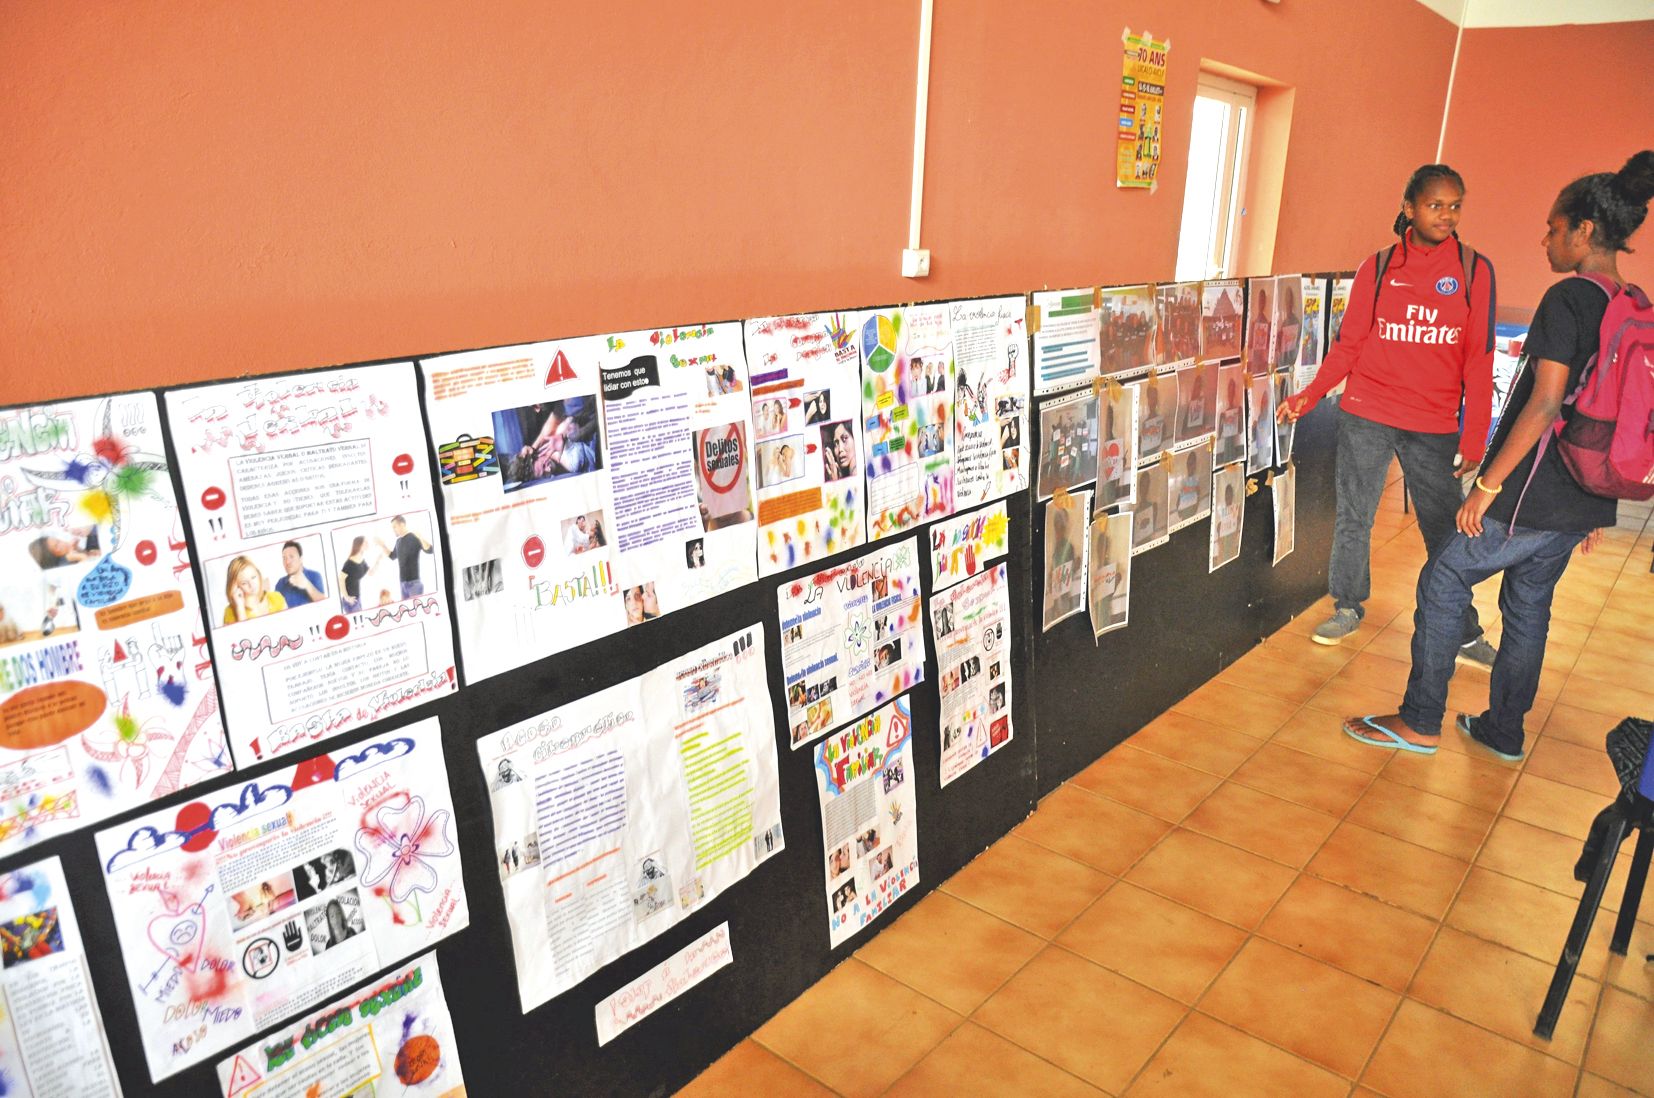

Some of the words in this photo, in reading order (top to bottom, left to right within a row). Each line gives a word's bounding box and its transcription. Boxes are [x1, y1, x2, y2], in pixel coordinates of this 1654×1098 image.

[1149, 51, 1166, 67] ANS
[1406, 304, 1438, 324] Fly
[1377, 318, 1461, 345] Emirates
[834, 344, 856, 357] BASTA
[602, 371, 631, 381] Tenemos
[634, 367, 646, 376] que
[603, 382, 618, 392] lidiar
[620, 380, 631, 389] con
[705, 437, 738, 459] Delitos
[707, 452, 740, 473] sexuales
[831, 913, 848, 931] NO
[865, 889, 877, 906] LA
